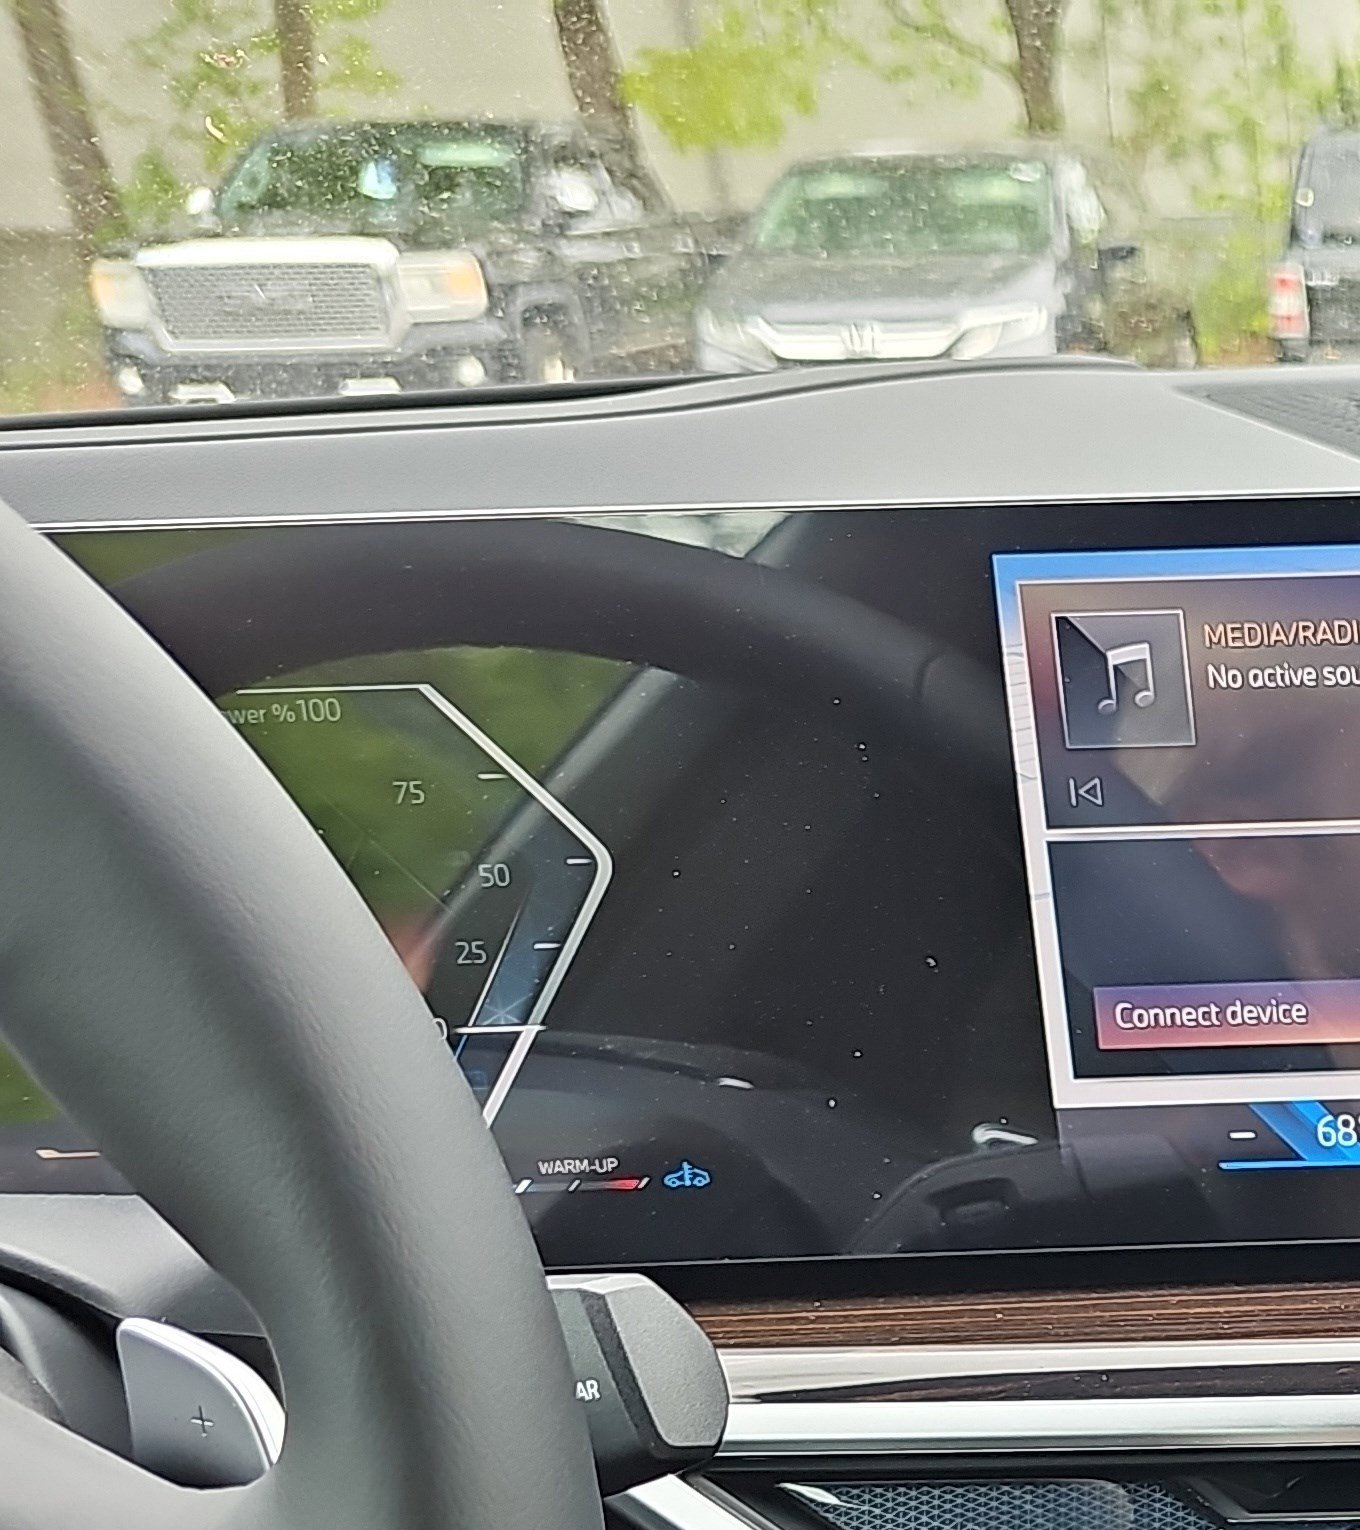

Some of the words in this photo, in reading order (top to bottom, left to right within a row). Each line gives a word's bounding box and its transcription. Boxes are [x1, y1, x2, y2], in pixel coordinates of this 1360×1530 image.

[1207, 664, 1244, 689] No
[1248, 660, 1317, 688] active
[222, 708, 267, 724] wer
[393, 781, 426, 804] 75
[478, 863, 511, 888] 50
[455, 941, 488, 965] 25
[1115, 1001, 1221, 1029] Connect
[1226, 998, 1308, 1025] device
[538, 1157, 619, 1176] WARM-UP
